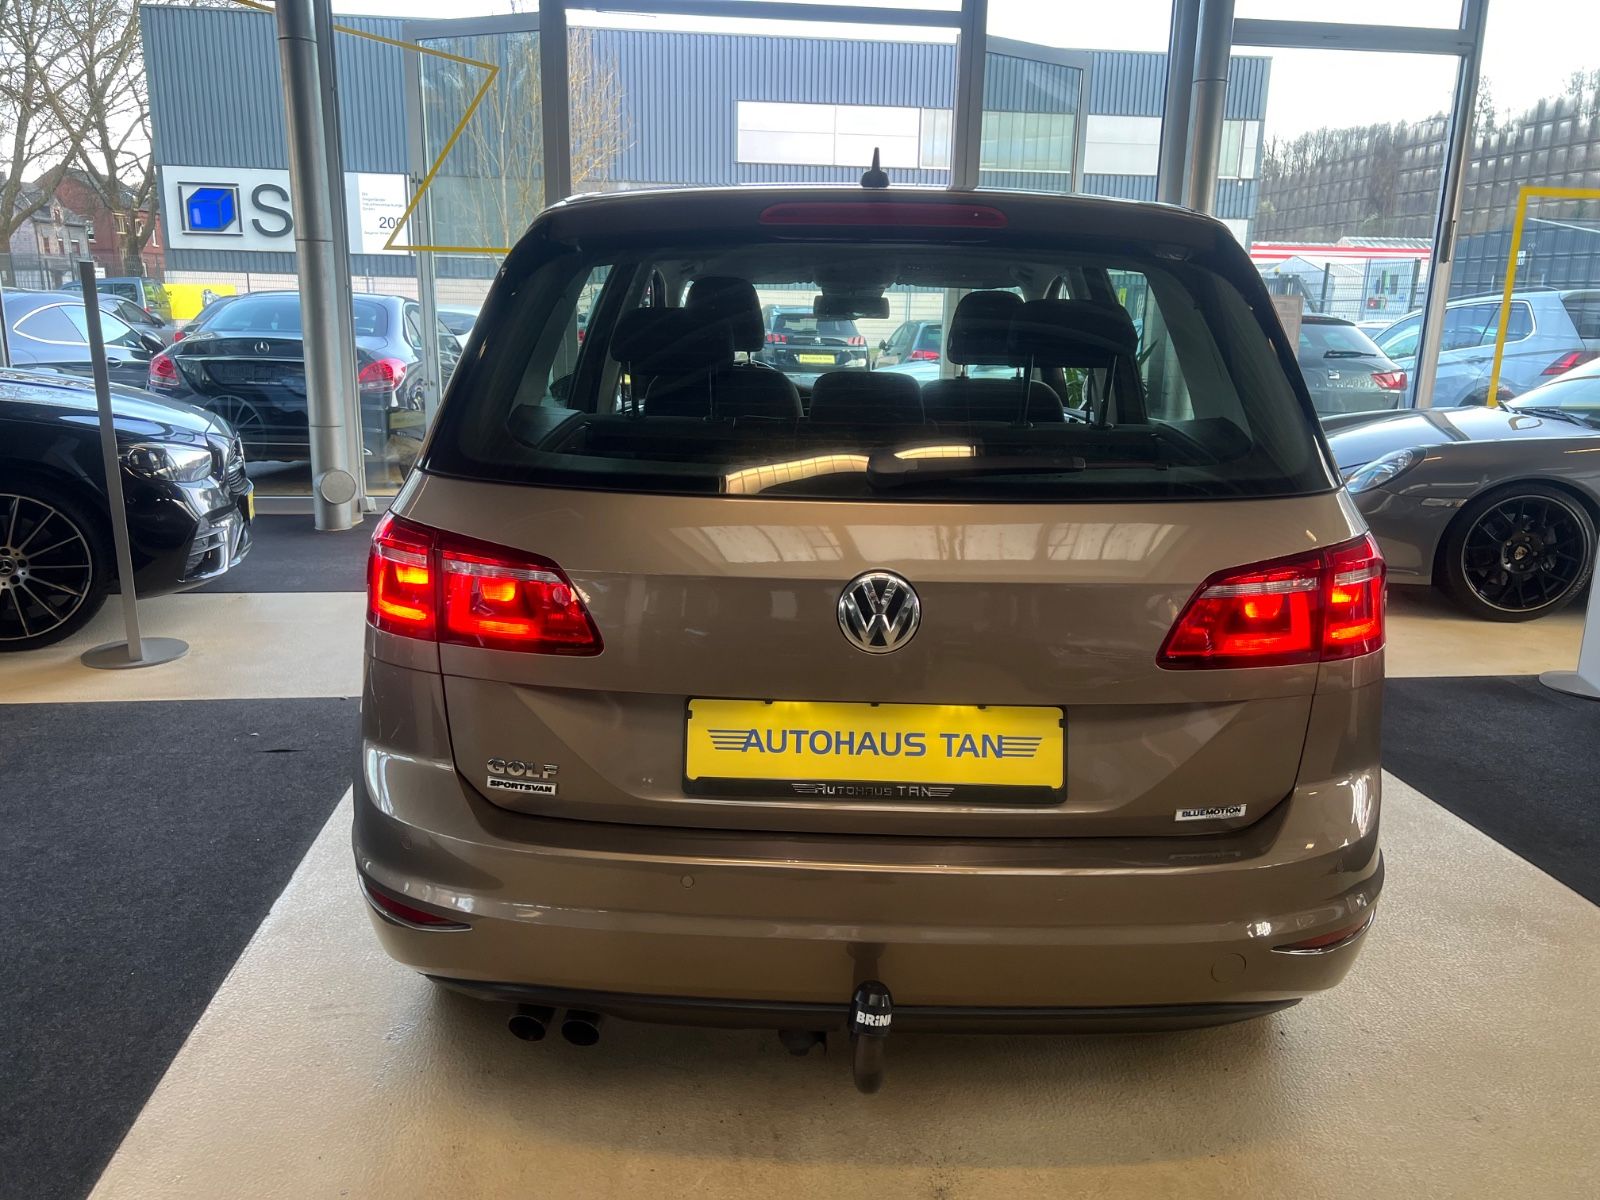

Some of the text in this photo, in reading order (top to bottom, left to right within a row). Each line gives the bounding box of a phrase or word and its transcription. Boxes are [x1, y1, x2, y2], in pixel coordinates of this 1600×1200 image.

[741, 728, 1003, 759] AUTOHAUS TAN
[486, 758, 559, 779] GOLF
[489, 780, 553, 793] SPORTSVAN
[815, 783, 931, 797] AUTOHAUS TAN
[1182, 807, 1242, 818] BLUEMOTION
